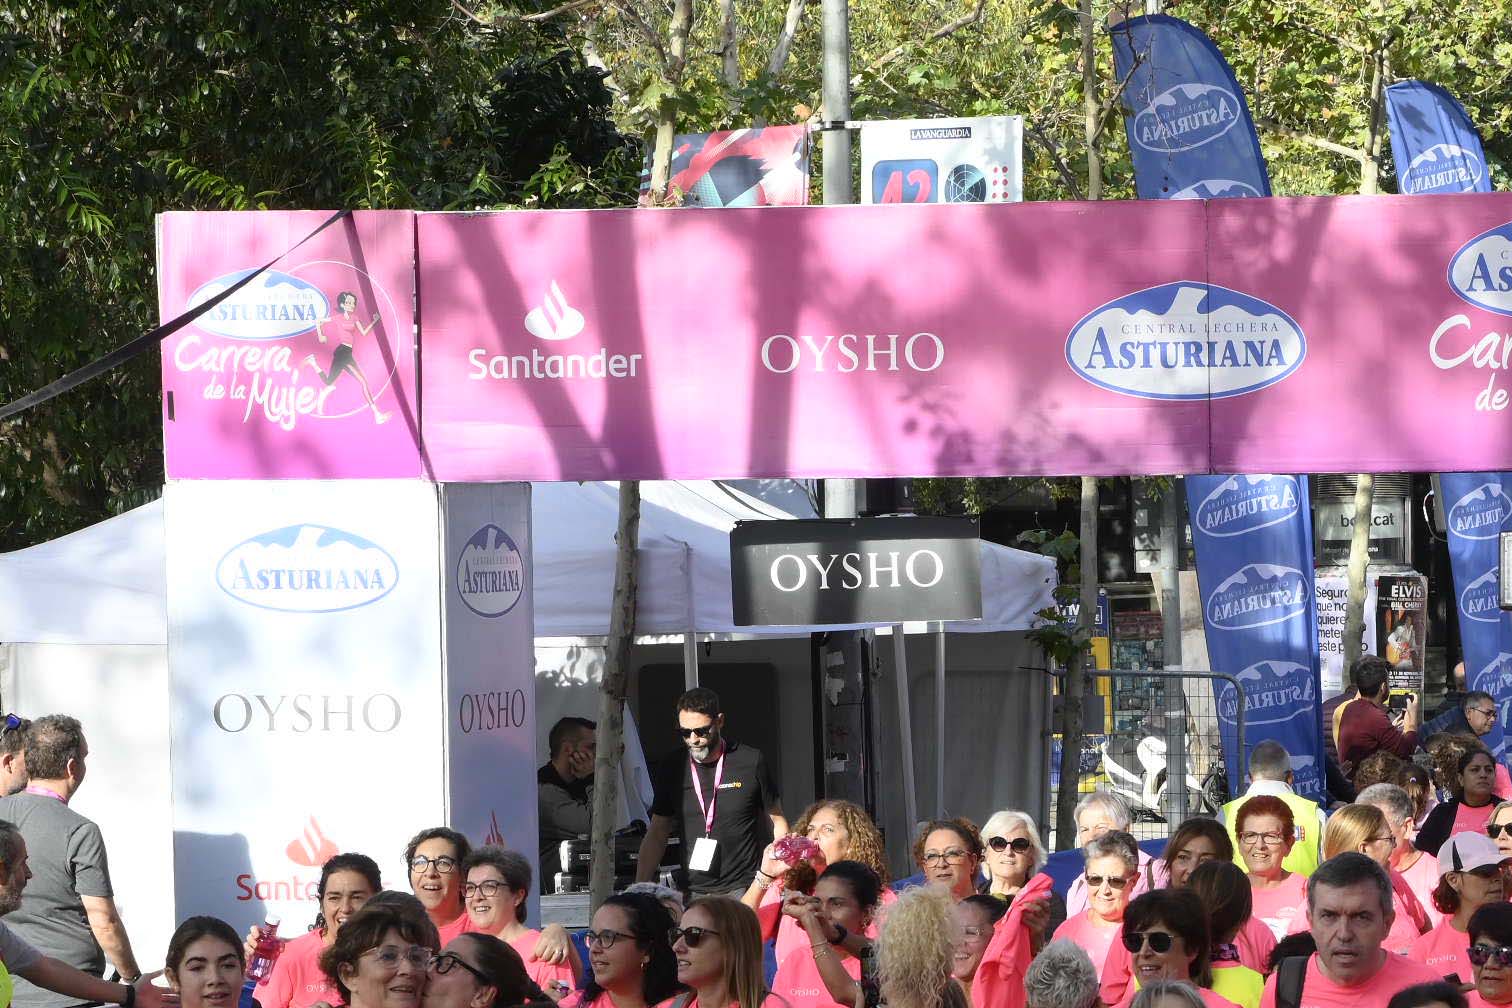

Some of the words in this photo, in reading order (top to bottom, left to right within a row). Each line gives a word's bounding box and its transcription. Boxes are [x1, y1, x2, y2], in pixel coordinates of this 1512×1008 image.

[207, 303, 319, 321] STURIANA
[1122, 322, 1196, 334] CENTRAL
[1204, 321, 1279, 333] LECHERA
[175, 335, 292, 373] Carrera
[469, 348, 642, 379] Santander
[761, 332, 945, 373] OYSHO
[1084, 326, 1288, 369] ASTURIANA
[203, 375, 226, 400] de
[231, 373, 247, 399] la
[243, 368, 337, 432] Mujer
[1475, 372, 1510, 412] de
[1340, 513, 1395, 528] b.cat
[232, 558, 385, 590] ASTURIANA
[463, 559, 520, 594] ASTURIANA
[770, 550, 945, 592] OYSHO
[1317, 602, 1333, 613] que
[1391, 585, 1422, 598] ELVIS
[1318, 642, 1337, 652] este
[213, 692, 402, 733] OYSHO
[459, 688, 526, 733] OYSHO
[306, 984, 328, 993] OYS
